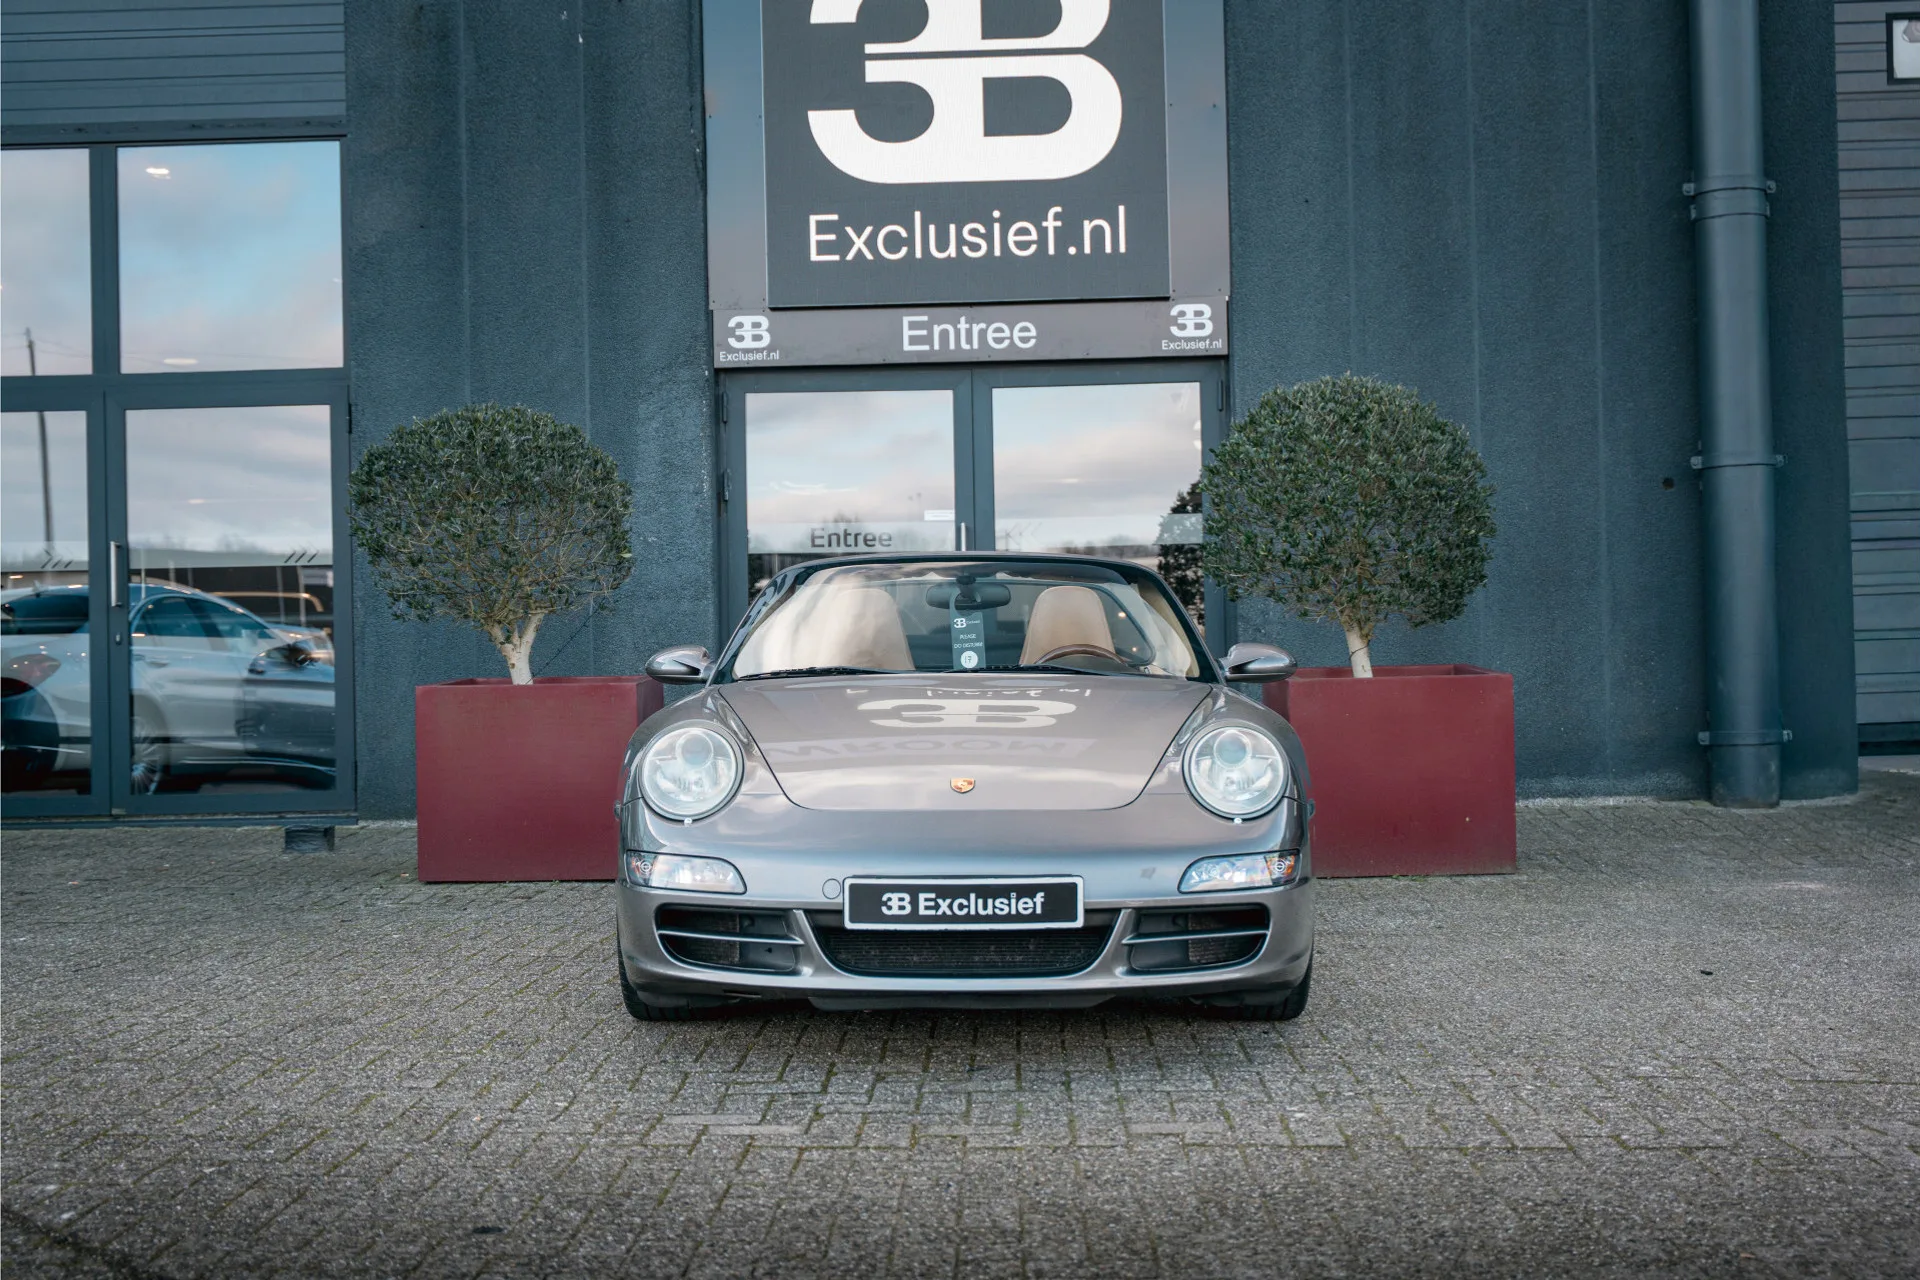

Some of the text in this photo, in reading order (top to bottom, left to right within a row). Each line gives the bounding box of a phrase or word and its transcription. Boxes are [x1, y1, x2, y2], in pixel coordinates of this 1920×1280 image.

[808, 205, 1128, 262] Exclusief.nl
[902, 315, 1037, 351] Entree
[1161, 338, 1222, 350] Exclusief.nl
[719, 349, 780, 362] Exclusief.nl
[810, 527, 893, 548] Entree
[918, 892, 1045, 915] Exclusief
